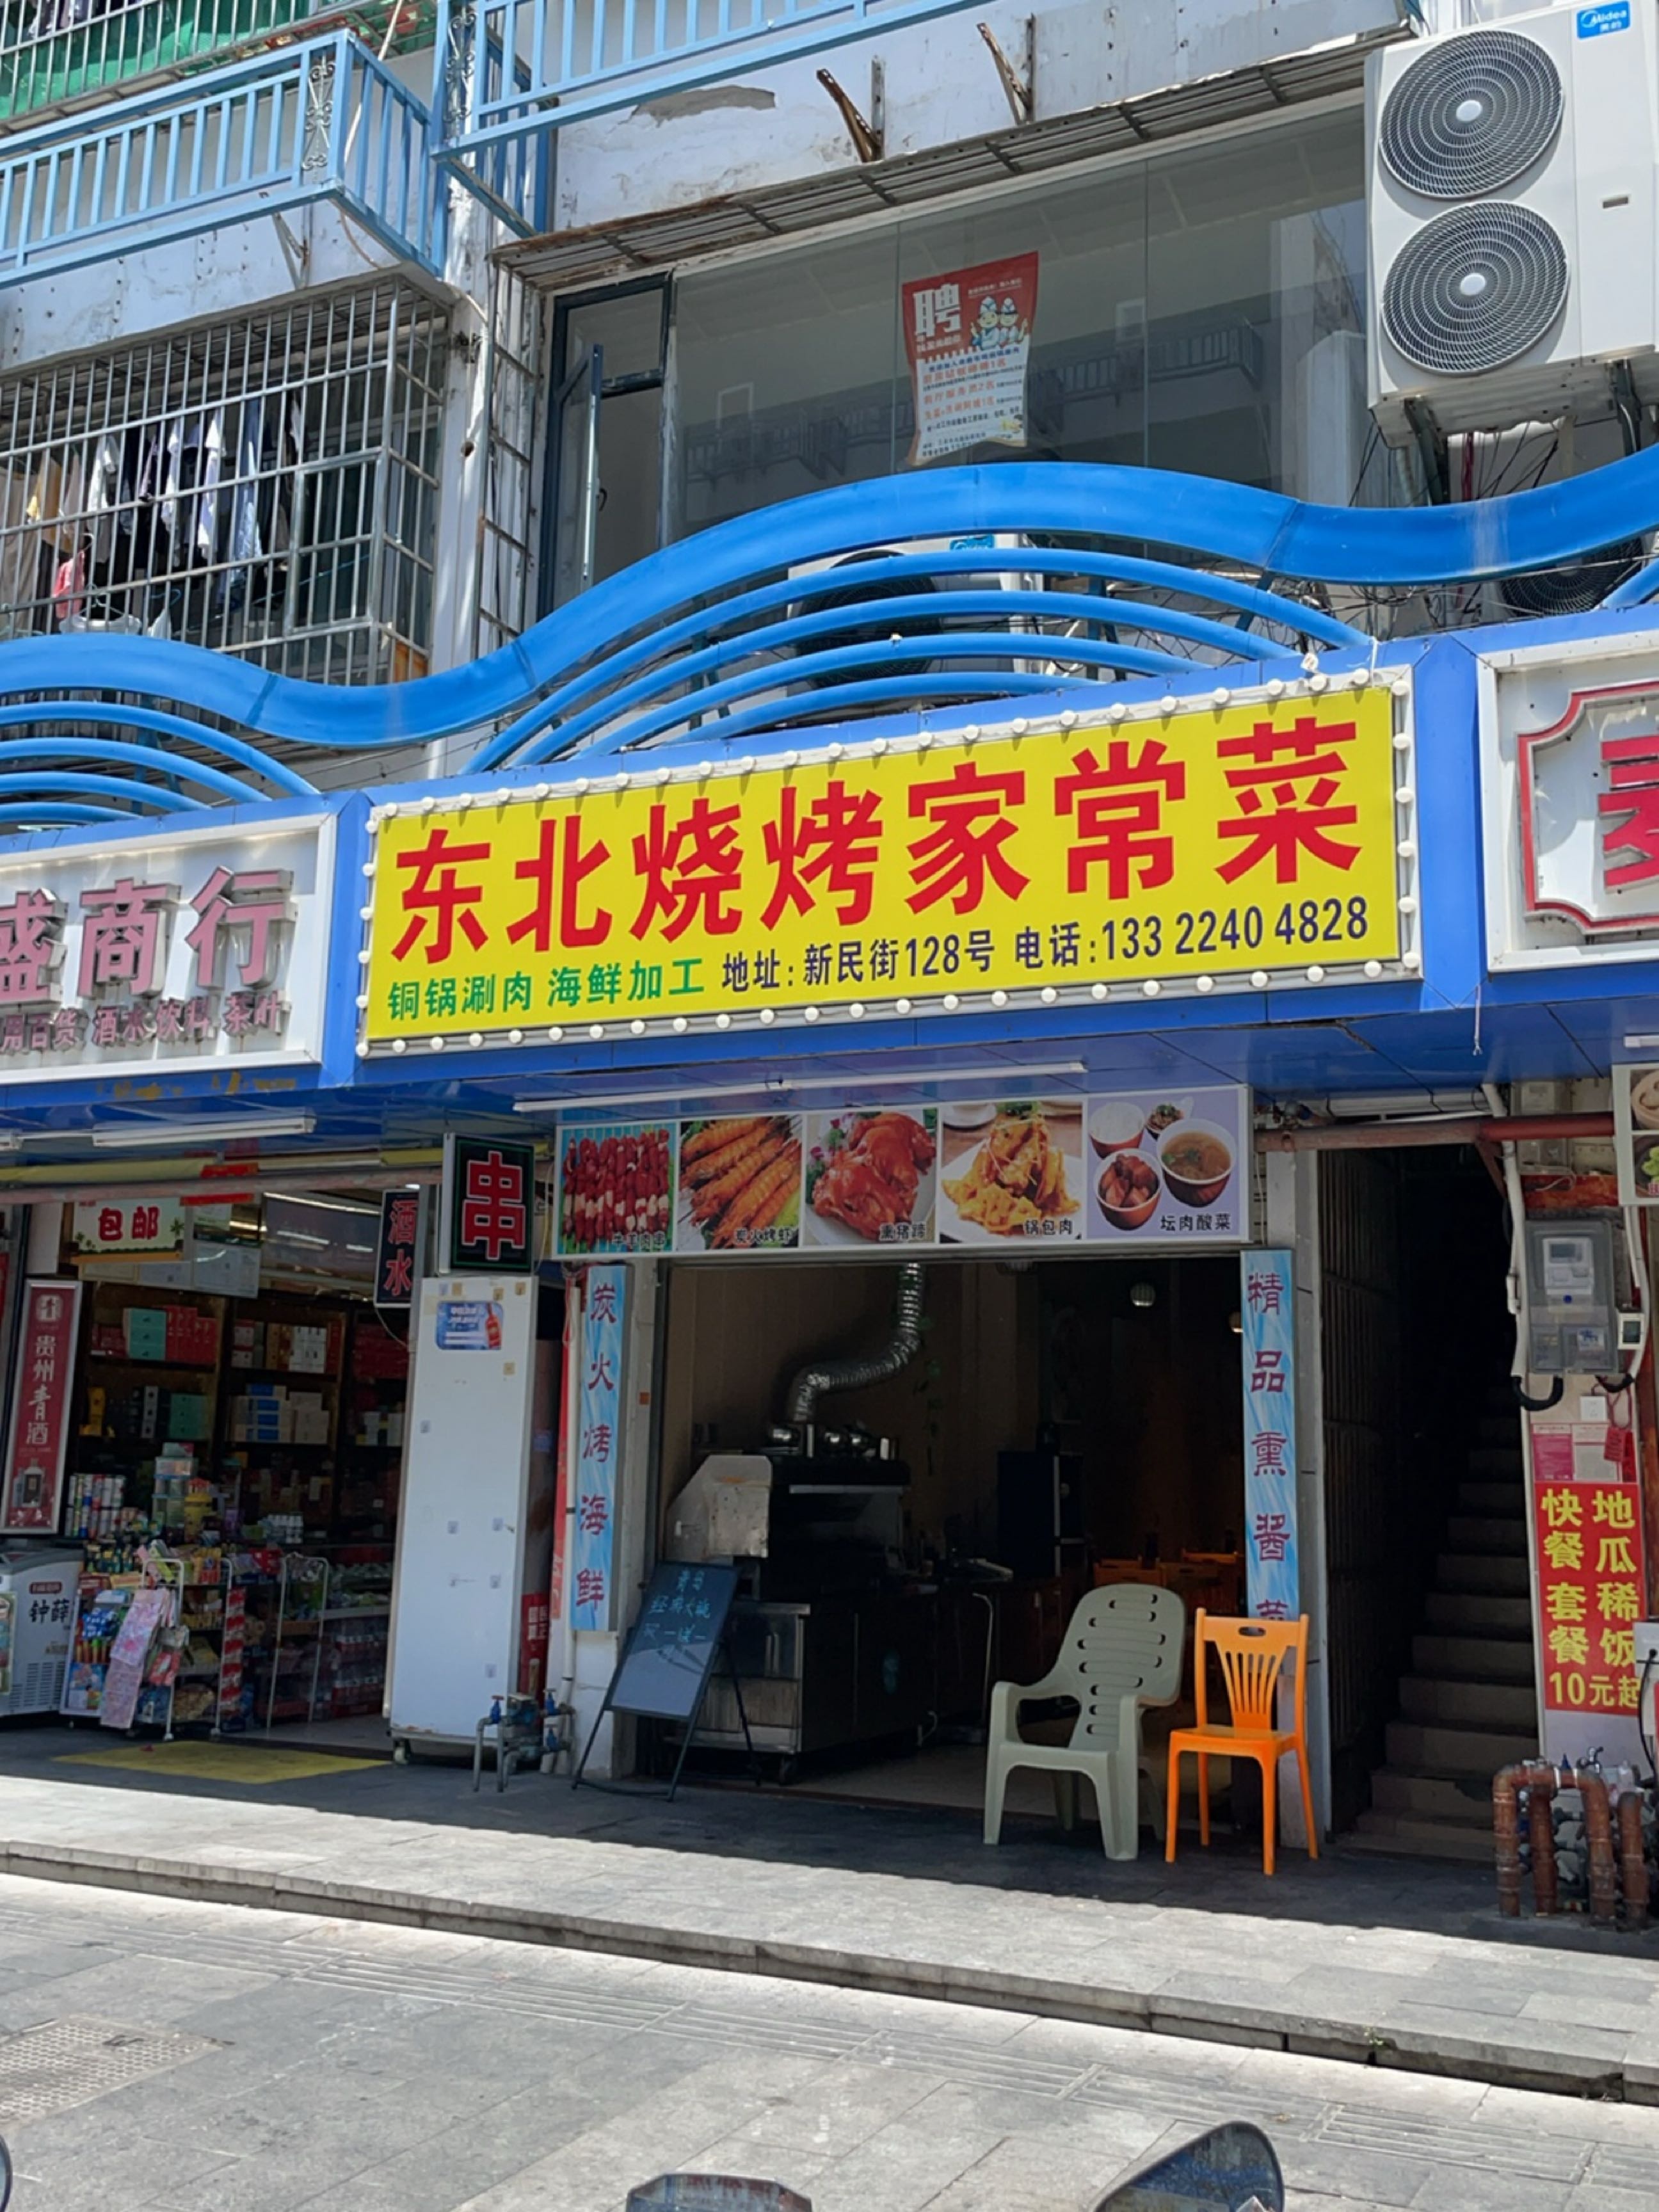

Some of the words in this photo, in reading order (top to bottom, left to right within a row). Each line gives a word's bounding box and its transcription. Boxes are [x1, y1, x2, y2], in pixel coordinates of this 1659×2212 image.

[390, 717, 1363, 965] 东北烧烤家常菜
[0, 864, 288, 1004] 盛商行
[1274, 896, 1368, 946] 4828
[387, 970, 533, 1021] 铜锅涮肉
[547, 958, 705, 1009] 海鲜加工
[99, 1205, 160, 1242] 包邮
[385, 1199, 418, 1297] 酒水
[462, 1151, 526, 1260] 串
[1024, 1219, 1073, 1237] 锅包肉
[1159, 1212, 1231, 1233] 坛肉酸菜
[575, 1283, 617, 1612] 炭火烤海鲜
[1541, 1487, 1589, 1666] 快餐套餐
[1591, 1490, 1640, 1668] 地瓜稀饭
